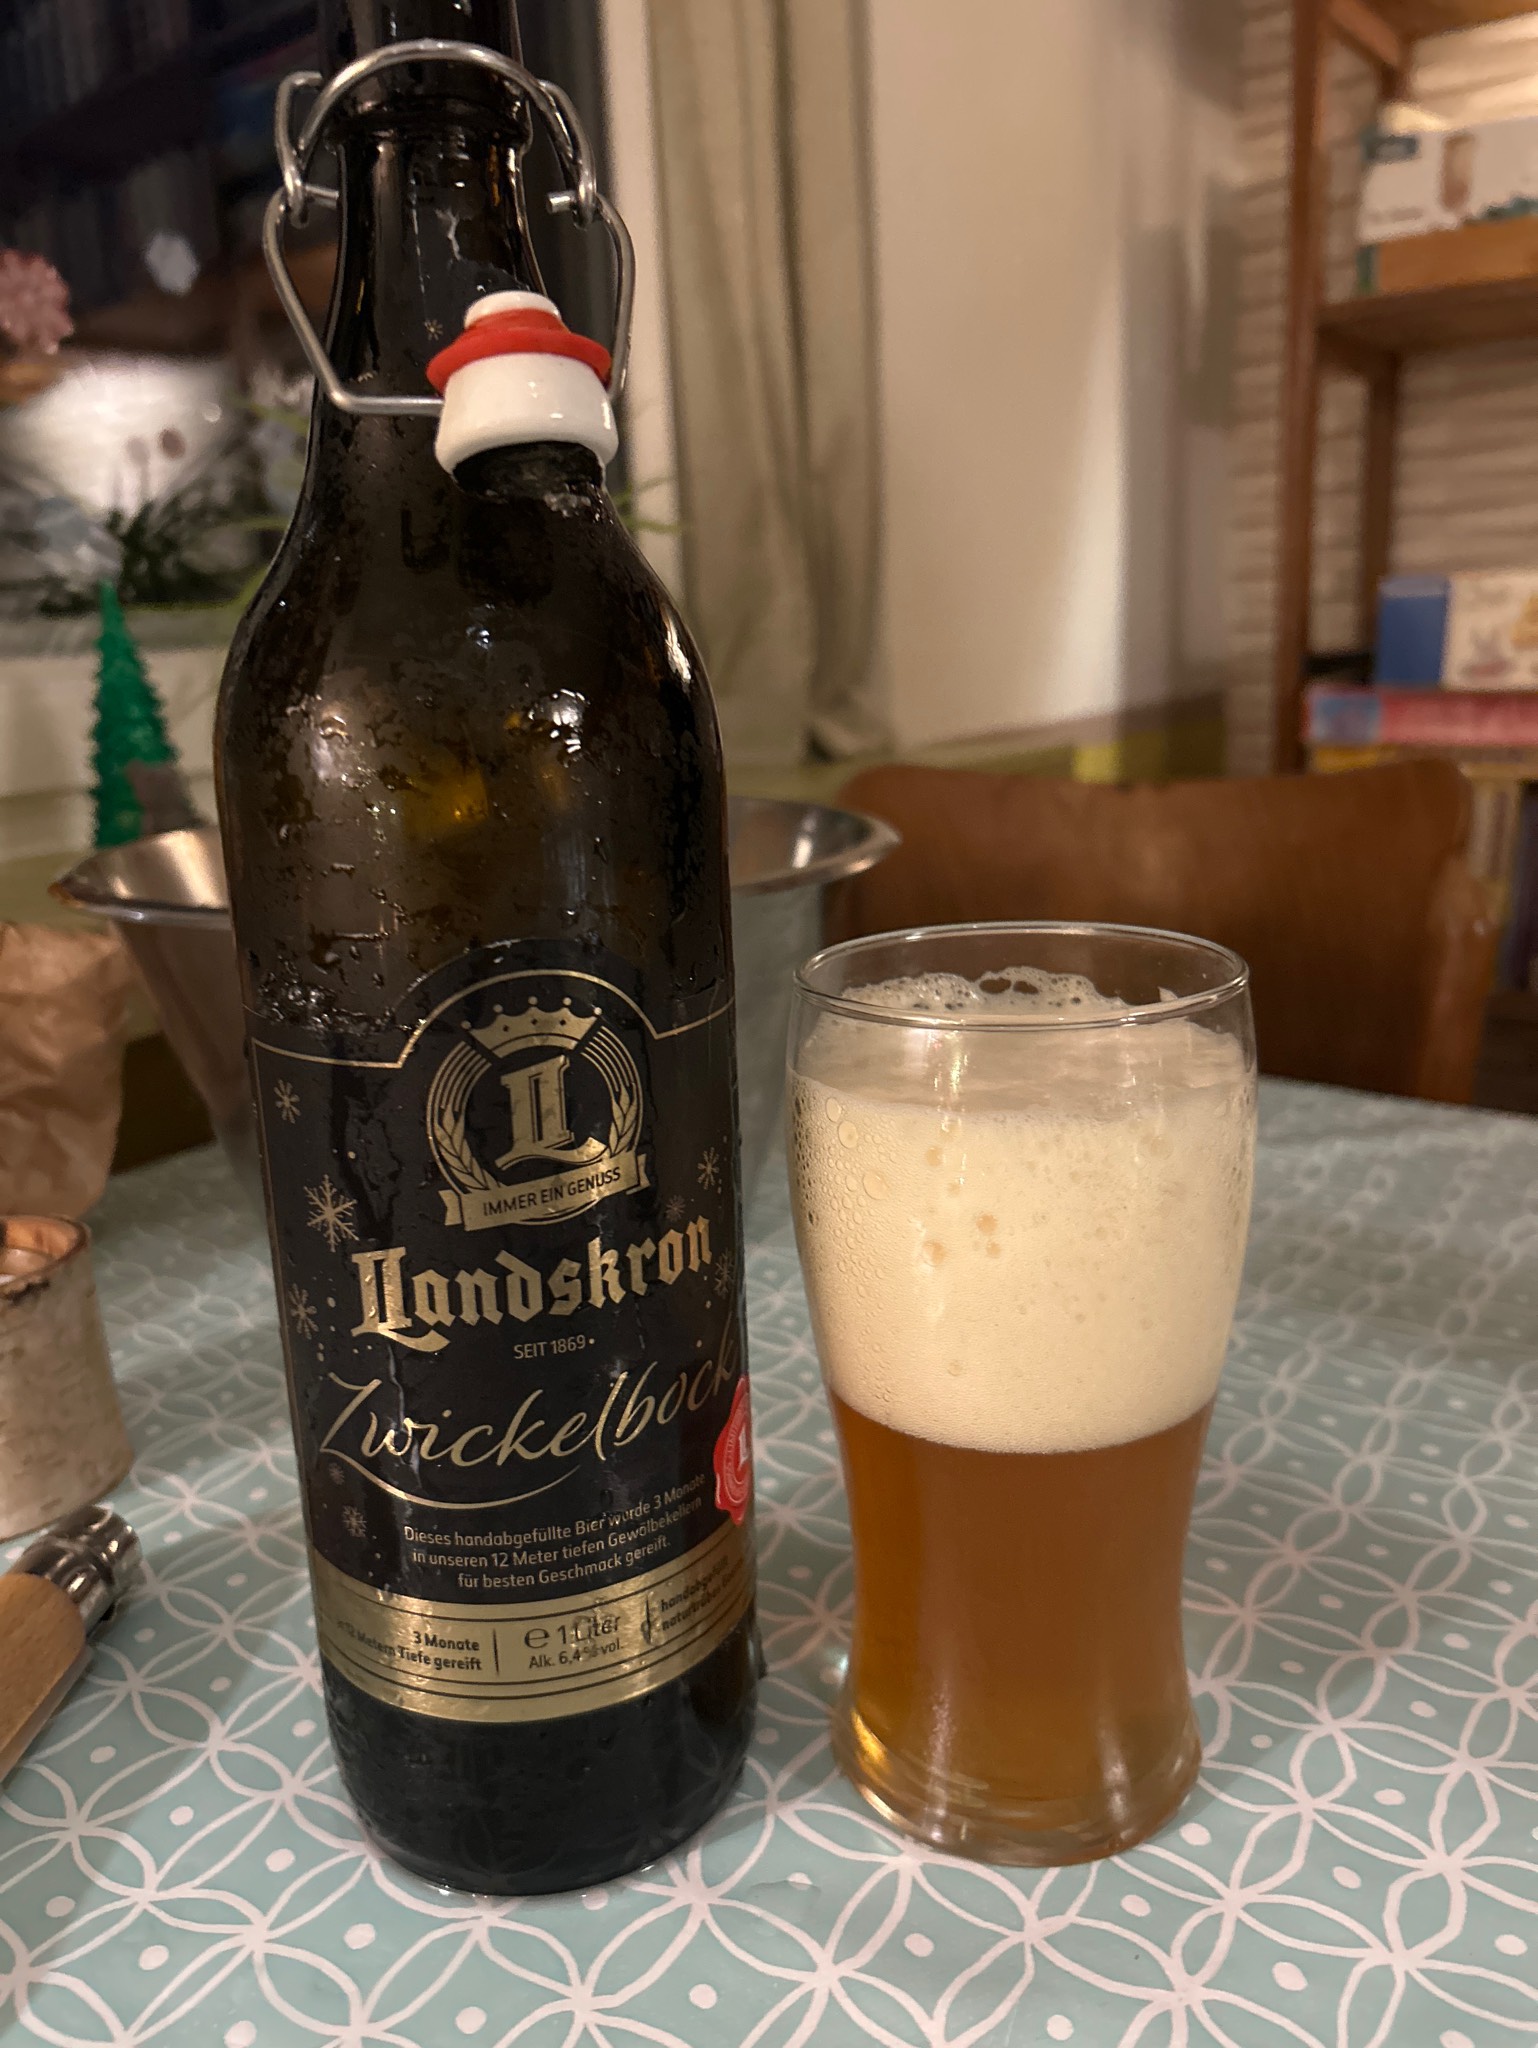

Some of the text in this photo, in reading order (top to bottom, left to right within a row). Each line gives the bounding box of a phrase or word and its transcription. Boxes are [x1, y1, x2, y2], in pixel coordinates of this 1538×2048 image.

[483, 1167, 621, 1217] IMMER EIN GENUSS
[351, 1214, 713, 1353] Landskron
[513, 1334, 586, 1360] SEIT 1869
[320, 1311, 738, 1470] Zwickelbock
[403, 1474, 706, 1549] Dieses handabgefüllte Bier wurde 3 Monate
[412, 1497, 702, 1568] in unseren 12 Meter tiefen Gewölbekellern
[458, 1534, 671, 1588] für besten Geschmack gereift.
[413, 1631, 480, 1651] 3 Monate
[529, 1654, 556, 1669] Alk.
[600, 1637, 625, 1655] vol.
[557, 1625, 567, 1645] 1
[574, 1616, 621, 1643] Liter
[397, 1645, 431, 1665] Tiefe
[434, 1656, 483, 1671] gereift
